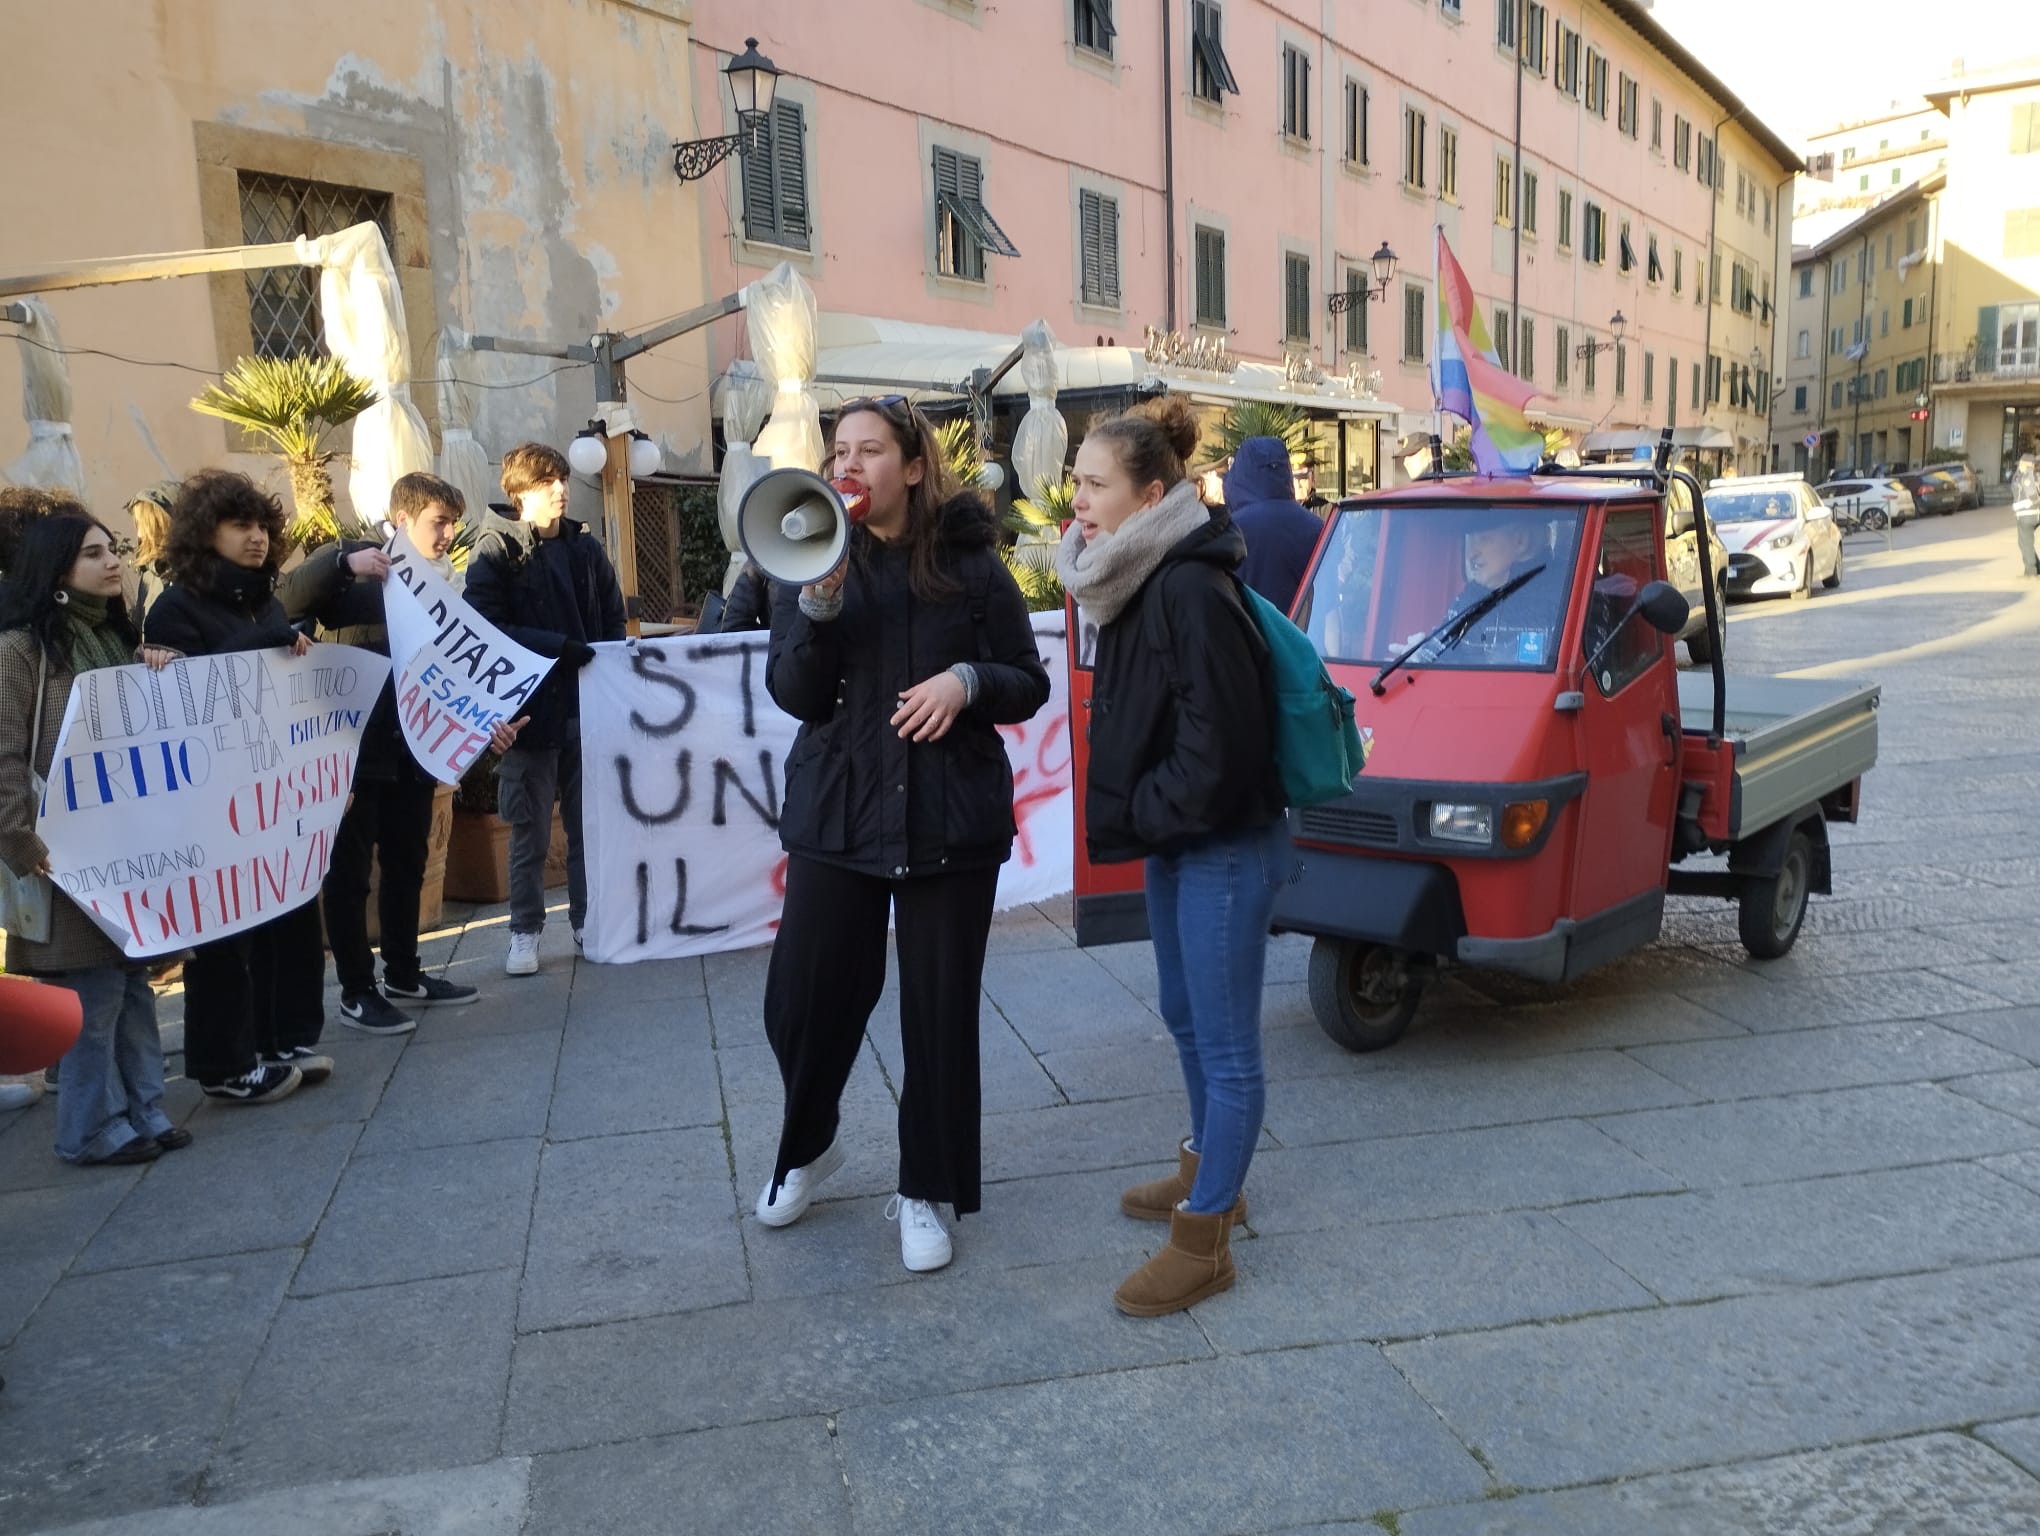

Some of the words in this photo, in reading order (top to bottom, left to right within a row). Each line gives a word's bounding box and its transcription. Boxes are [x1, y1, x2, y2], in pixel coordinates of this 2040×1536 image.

[63, 651, 280, 747] ALDITARA
[288, 672, 308, 706] IL
[312, 665, 357, 699] TUO
[420, 663, 503, 732] ESAME
[630, 641, 769, 738] ST
[242, 715, 272, 746] LA
[245, 738, 284, 773] TUA
[291, 709, 367, 746] ISTRUZIONE
[296, 817, 305, 837] E
[61, 843, 206, 895] DIVENTANO
[91, 823, 337, 947] DISCRIMINAZIO
[636, 857, 729, 944] IL
